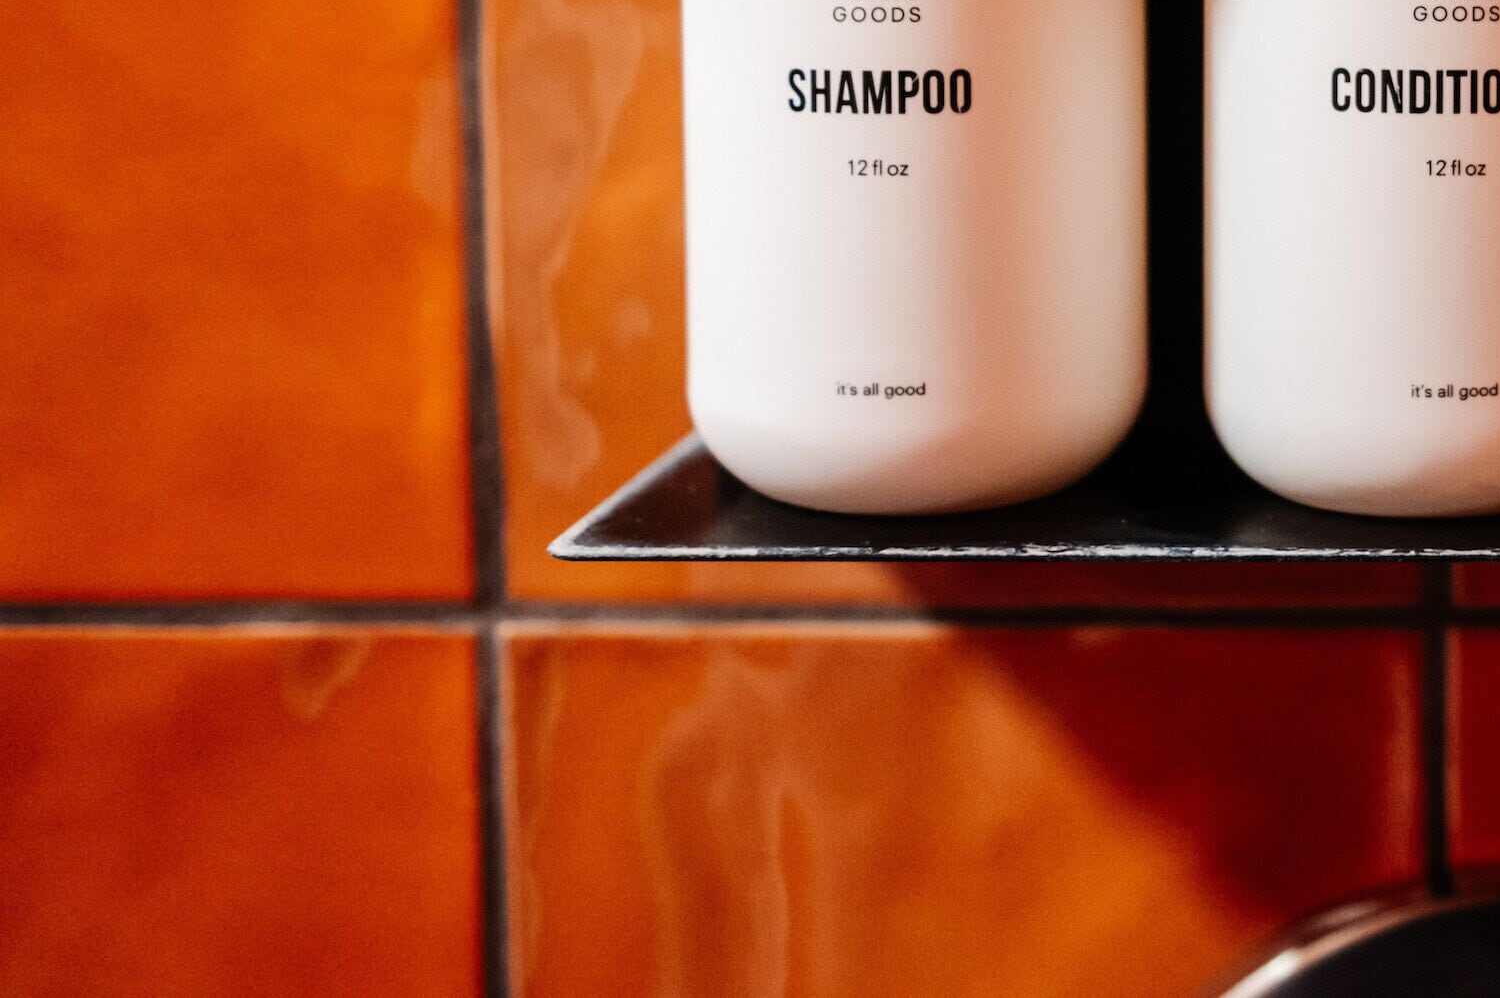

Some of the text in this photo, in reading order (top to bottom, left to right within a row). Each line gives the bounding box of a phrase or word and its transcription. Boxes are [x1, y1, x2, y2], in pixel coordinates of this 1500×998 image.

[832, 5, 922, 23] GOODS
[1412, 5, 1500, 23] GOODS
[787, 67, 973, 115] SHAMPOO
[847, 159, 909, 177] 12 fl oz
[1425, 159, 1487, 177] 12 fl oz
[862, 382, 880, 396] all
[884, 382, 927, 400] good
[1411, 382, 1499, 402] it's all good
